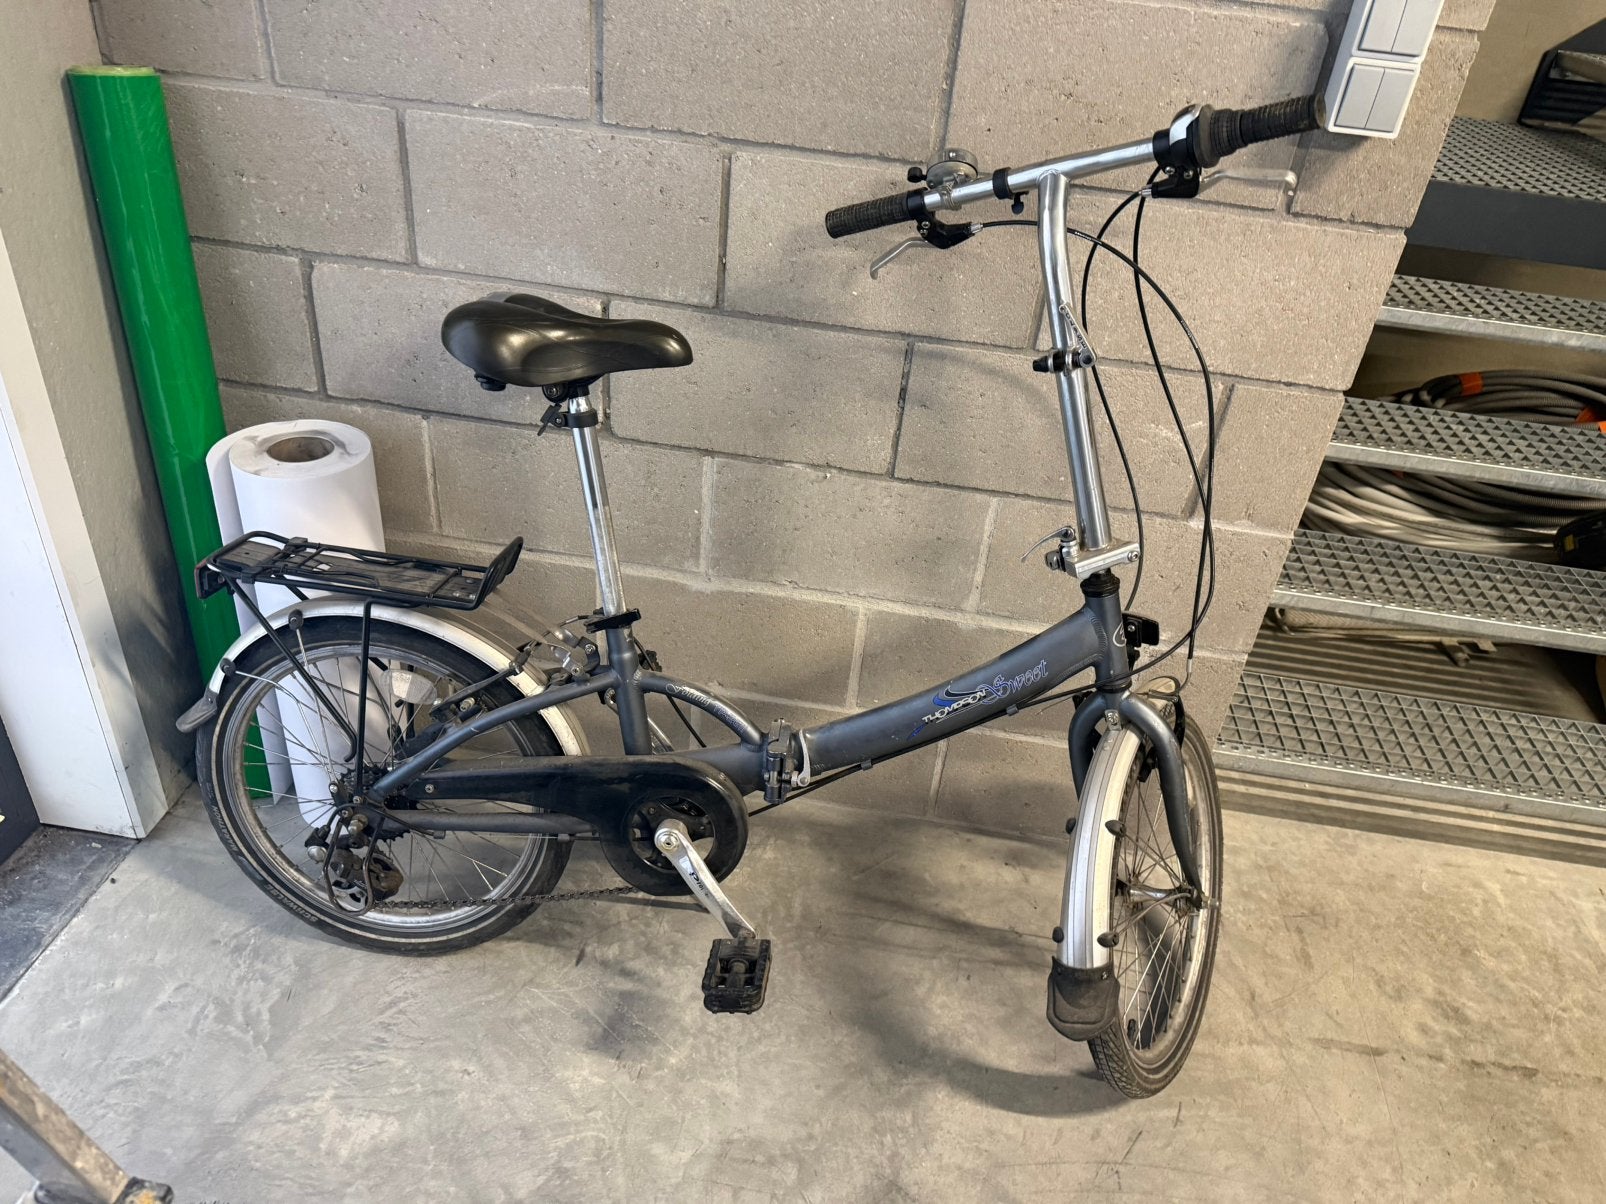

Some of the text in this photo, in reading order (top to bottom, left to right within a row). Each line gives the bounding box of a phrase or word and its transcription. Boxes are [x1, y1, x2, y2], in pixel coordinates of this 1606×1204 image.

[922, 659, 1048, 724] THOMPSON Sweet
[211, 805, 238, 852] MARATHON
[264, 883, 319, 923] SCHWALBE
